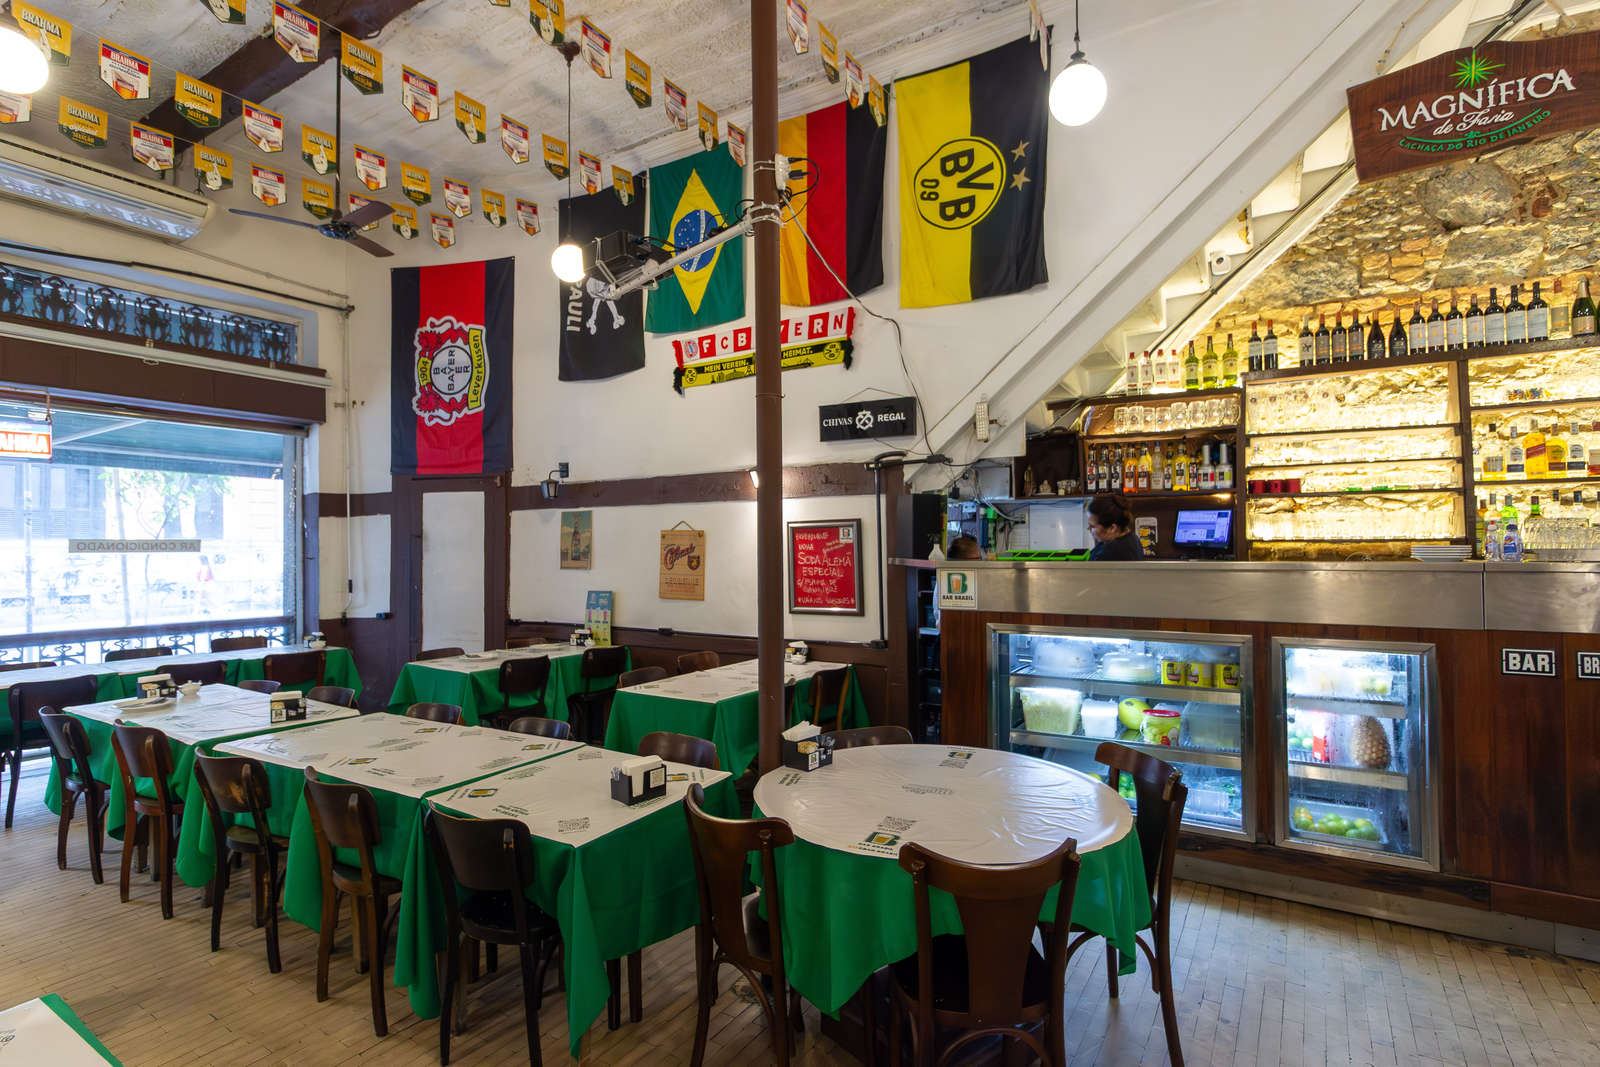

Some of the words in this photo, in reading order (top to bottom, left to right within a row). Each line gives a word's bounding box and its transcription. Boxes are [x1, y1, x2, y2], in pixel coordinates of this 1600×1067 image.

[22, 9, 62, 38] BRAHMA
[283, 10, 309, 30] BRAHMA
[110, 50, 139, 69] BRAHMA
[348, 43, 376, 67] BRAHMA
[183, 80, 215, 103] BRAHMA
[1377, 68, 1576, 131] MAGNÍFICA
[67, 103, 100, 126] BRAHMA
[1432, 119, 1453, 136] de
[1456, 108, 1514, 131] Faria
[1446, 143, 1464, 151] DO
[1467, 138, 1486, 148] RIO
[1491, 134, 1505, 142] DE
[1508, 110, 1551, 137] JANEIRO
[920, 179, 940, 201] 09
[939, 148, 994, 221] BVB
[420, 360, 430, 383] 1904
[470, 335, 482, 403] Leverkusen
[704, 363, 721, 373] MEIN
[823, 417, 852, 427] CHIVAS
[877, 412, 906, 422] REGAL
[802, 567, 844, 577] ESPECIAL
[1508, 653, 1550, 672] BAR
[1583, 656, 1600, 674] BR
